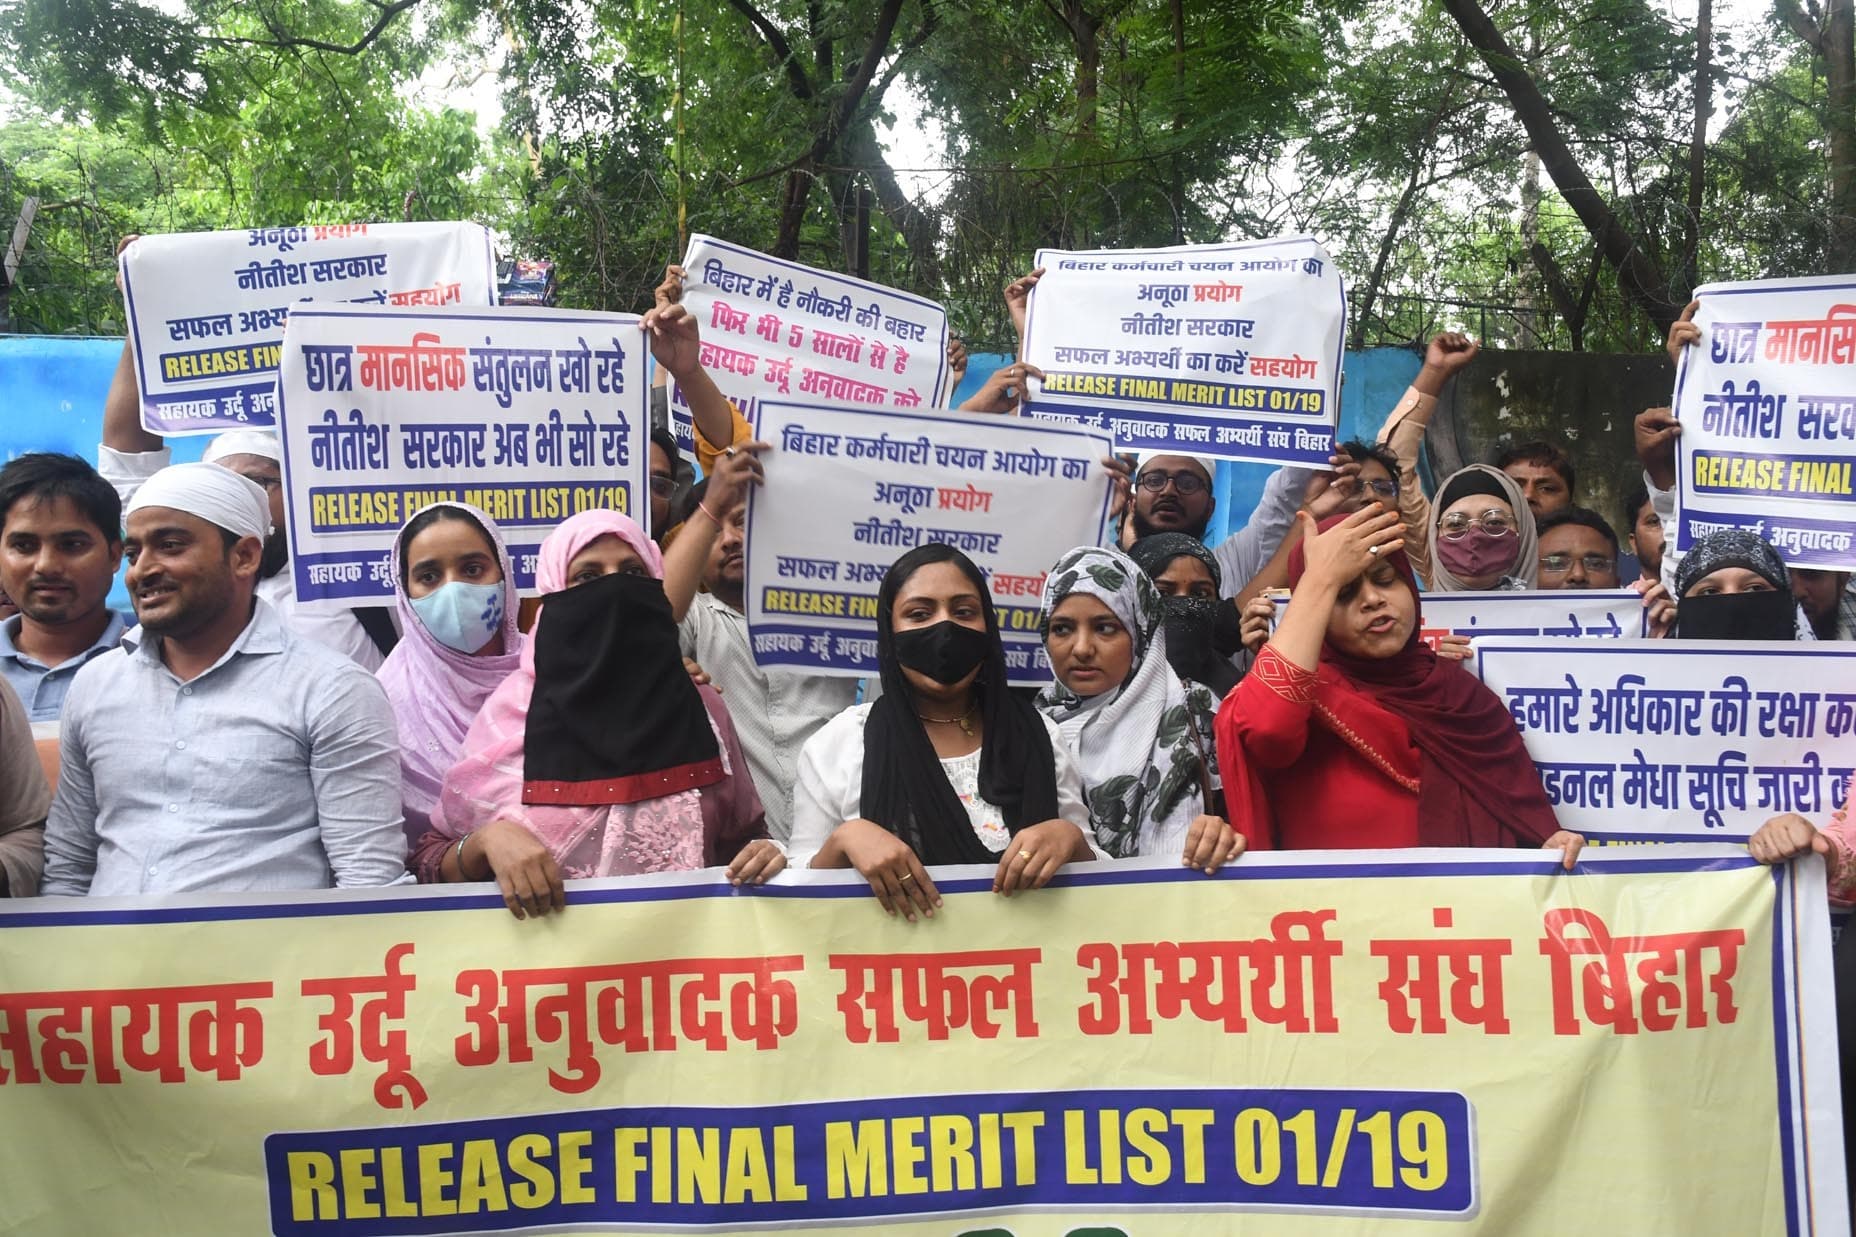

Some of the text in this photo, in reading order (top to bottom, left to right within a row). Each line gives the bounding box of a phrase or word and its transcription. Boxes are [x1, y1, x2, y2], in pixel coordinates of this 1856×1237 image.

[235, 254, 388, 290] नीतीश सरकार
[1058, 259, 1106, 272] बिहार
[1188, 261, 1234, 273] चयन
[1239, 256, 1298, 273] आयोग
[1302, 257, 1323, 277] का
[702, 258, 927, 342] बिहार में है नौकरी की बहार
[1137, 280, 1243, 307] अनूठा प्रयोग
[166, 314, 232, 341] सफल
[711, 300, 910, 375] फिर भी 5 सालों से है
[1121, 312, 1255, 339] नीतीश सरकार
[1711, 304, 1856, 365] छात्र मानसि
[165, 344, 283, 379] RELEASE FIN
[301, 344, 354, 392] छात्र
[357, 332, 467, 391] मानसिक
[469, 336, 552, 408] संतुलन
[556, 336, 592, 394] खो
[594, 336, 626, 394] रहे
[700, 340, 758, 376] हायक
[764, 356, 793, 395] उर्दू
[1054, 346, 1318, 380] सफल अभ्यर्थी का करें सहयोग
[157, 398, 216, 421] सहायक
[221, 391, 248, 421] उर्दू
[1045, 373, 1322, 412] RELEASE FINAL MERIT LIST 01/19
[1702, 379, 1787, 440] नीतीश
[308, 409, 631, 471] नीतीश सरकार अब भी सो रहे
[781, 425, 1090, 482] बिहार कर्मचारी चयन आयोग का
[1109, 417, 1170, 441] अनुवादक
[1173, 423, 1211, 442] सफल
[1267, 426, 1291, 449] संघ
[1295, 428, 1331, 451] बिहार
[1695, 456, 1852, 495] RELEASE FINAL
[313, 490, 399, 526] RELEASE
[465, 489, 526, 521] MERIT
[531, 488, 569, 519] LIST
[574, 486, 628, 515] 01/19
[873, 480, 993, 514] अनूठा प्रयोग
[853, 517, 1003, 555] नीतीश सरकार
[1770, 526, 1854, 556] अनुवादक
[308, 561, 363, 585] सहायक
[776, 555, 841, 582] सफल
[764, 588, 846, 617] RELEASE
[848, 596, 879, 619] FIN
[1011, 608, 1041, 631] 01/
[835, 635, 879, 664] अनुवा
[1506, 673, 1582, 734] हमारे
[1589, 673, 1705, 736] अधिकार
[1710, 676, 1752, 737] की
[1756, 691, 1821, 738] रक्षा
[1621, 748, 1682, 810] मेधा
[1686, 750, 1750, 828] सूचि
[1753, 751, 1824, 812] जारी
[0, 907, 1746, 1111] सहायक उर्दू अनुवादक सफल अभ्यर्थी संघ बिहार
[287, 1107, 1450, 1222] RELEASE FINAL MERIT LIST 01/19
